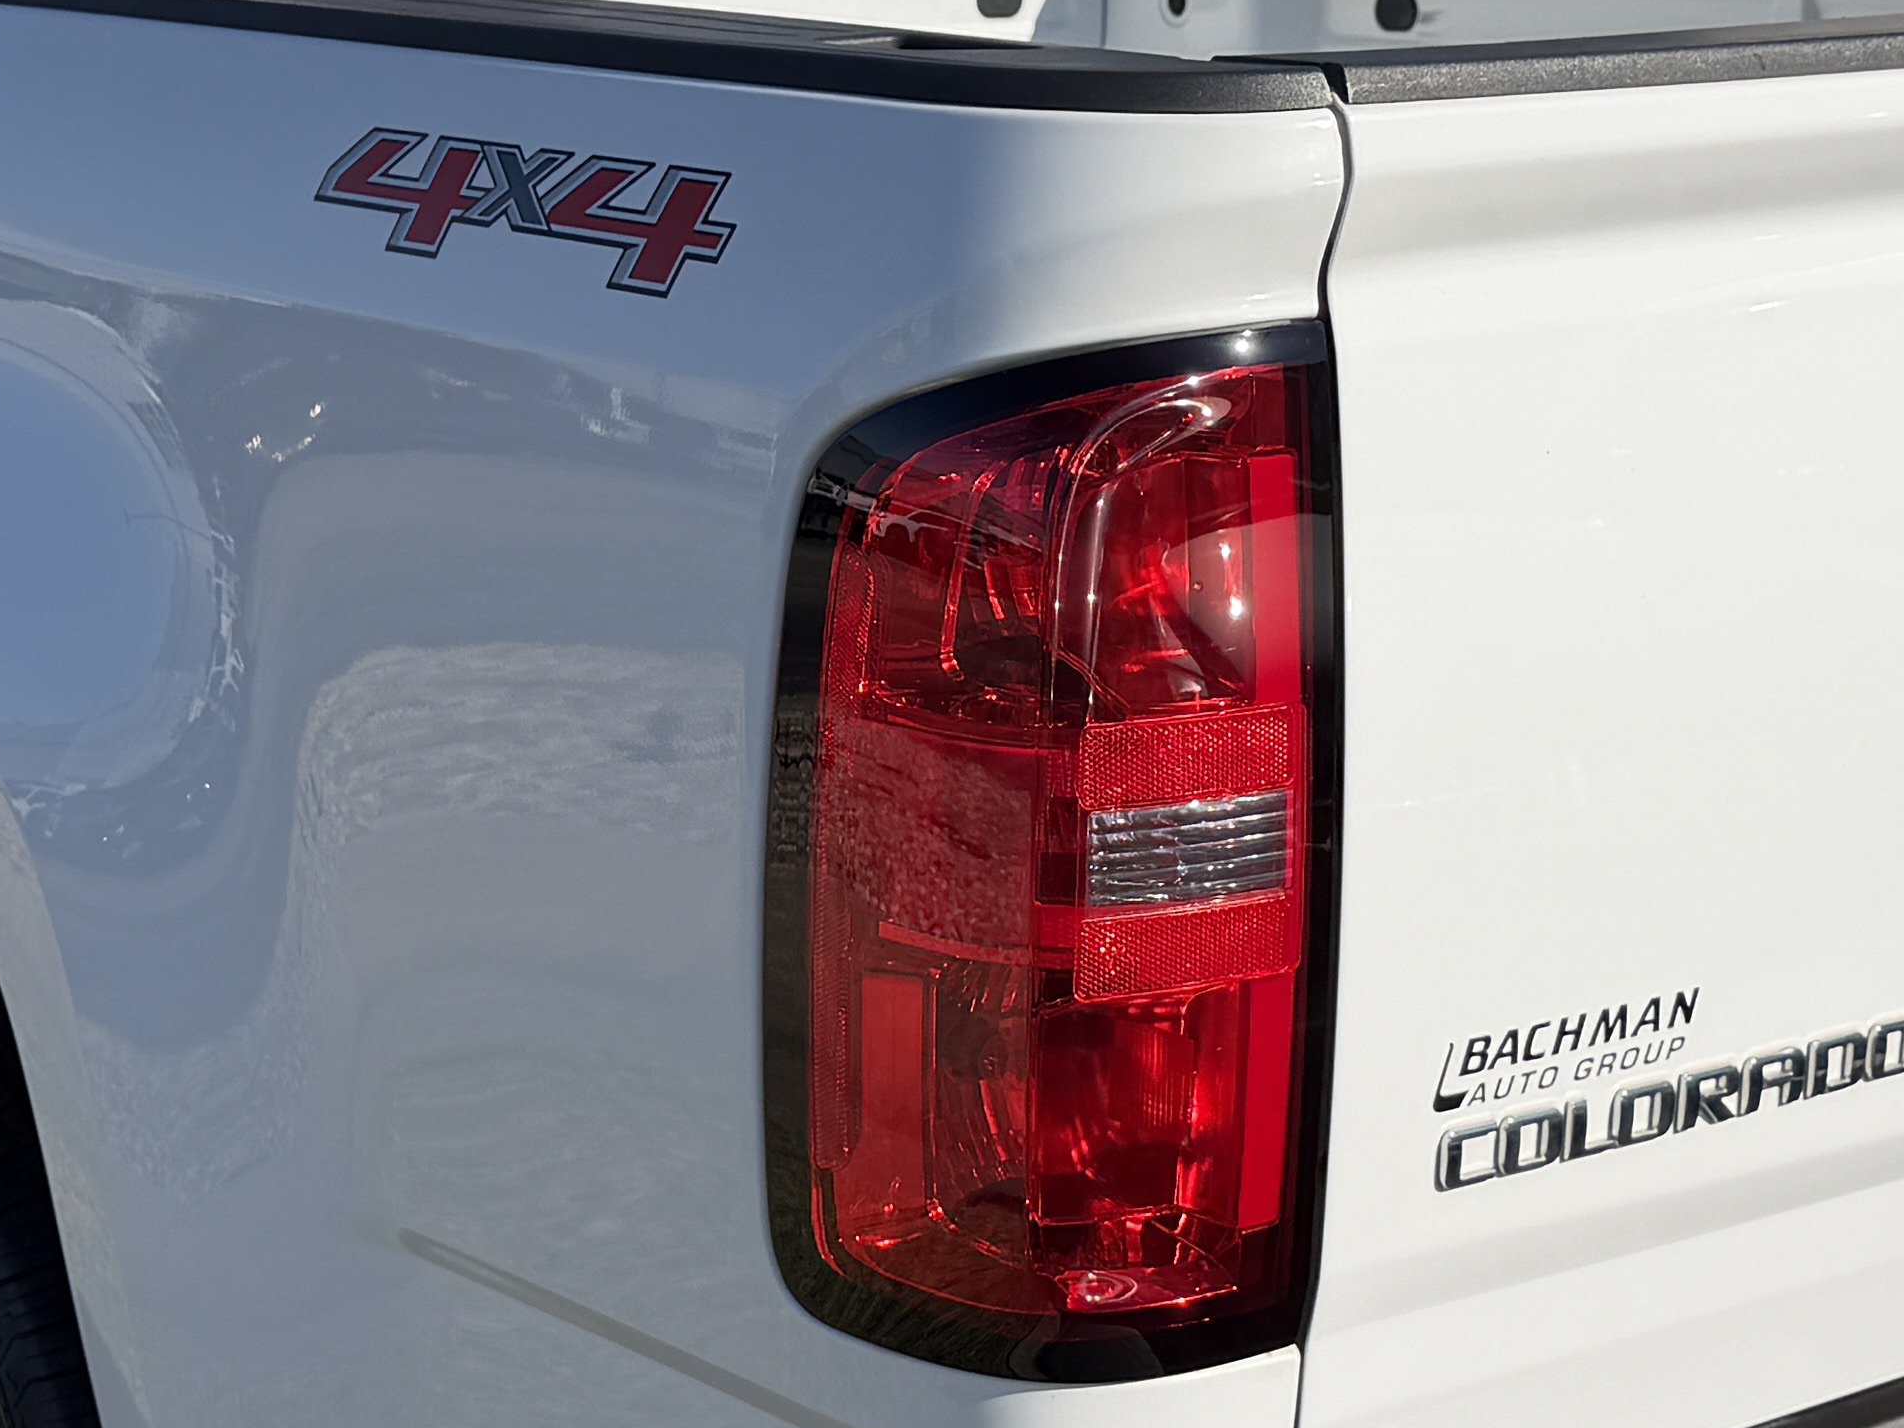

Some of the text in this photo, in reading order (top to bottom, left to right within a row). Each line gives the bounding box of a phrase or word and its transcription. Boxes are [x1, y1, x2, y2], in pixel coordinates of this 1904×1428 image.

[1459, 986, 1701, 1077] BACHMAN
[1466, 1035, 1686, 1107] AUTO GROUP
